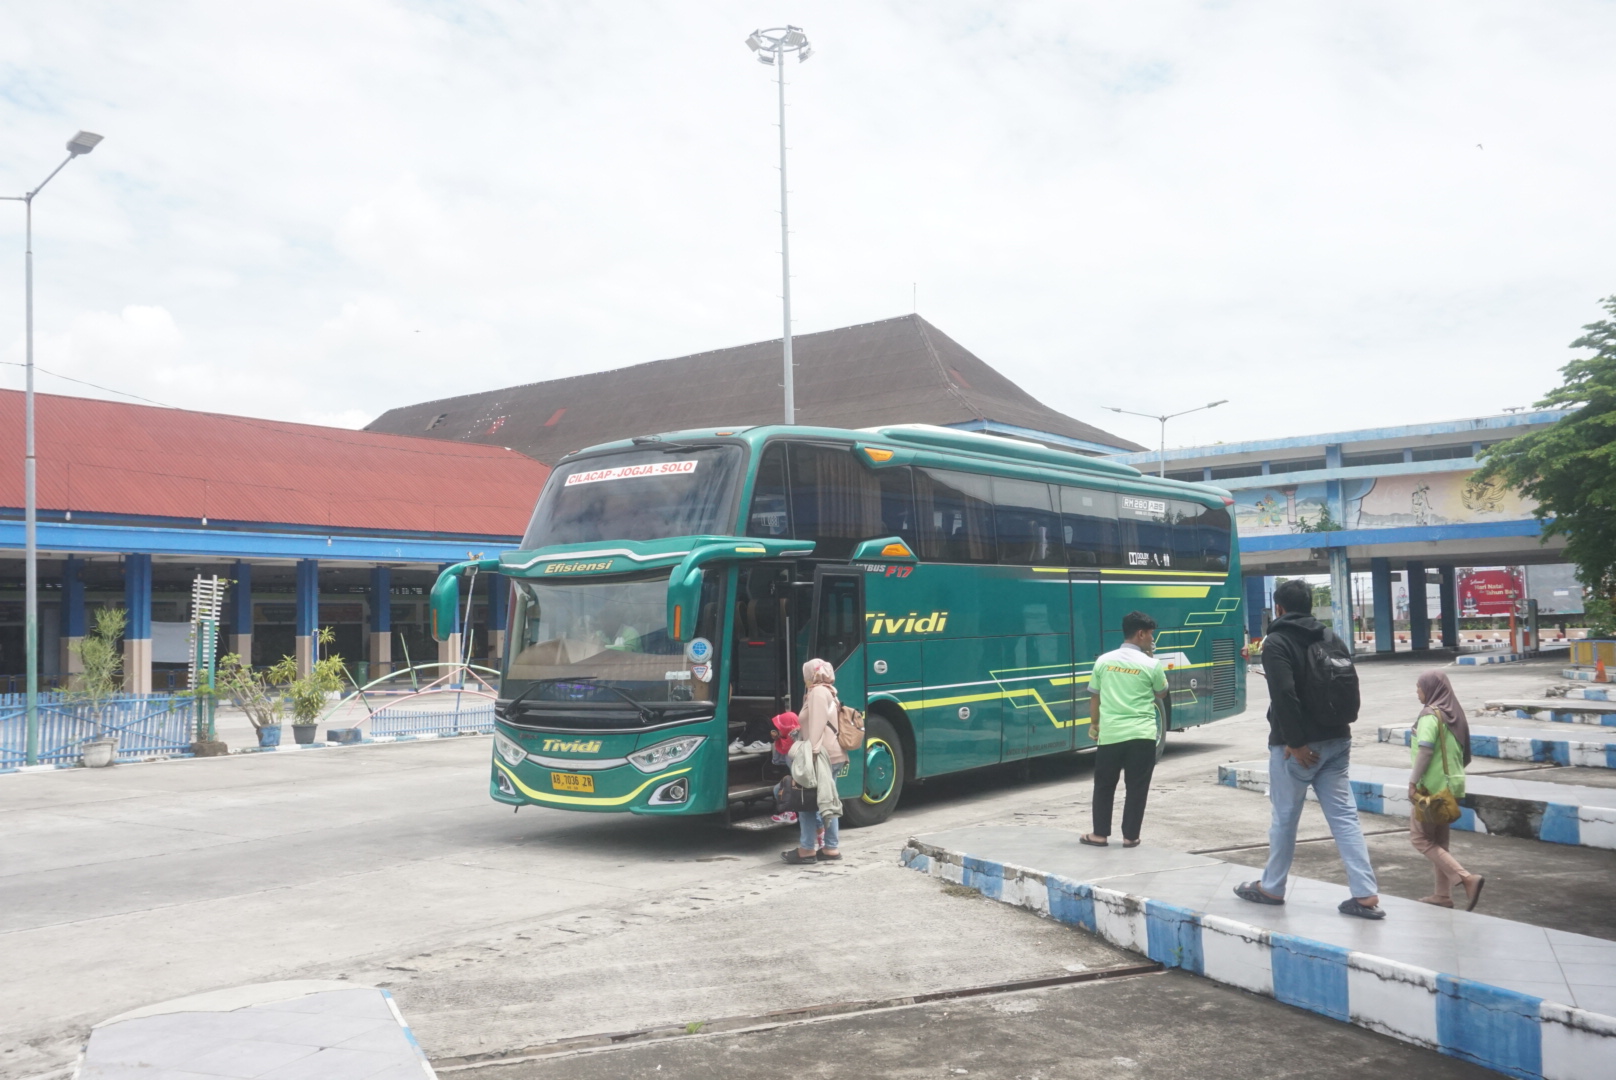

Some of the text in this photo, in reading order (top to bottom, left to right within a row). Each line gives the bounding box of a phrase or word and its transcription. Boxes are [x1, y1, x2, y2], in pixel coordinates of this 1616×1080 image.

[568, 470, 612, 483] CILACAP
[617, 465, 653, 477] JOGJA
[660, 462, 693, 474] SOLO
[544, 560, 613, 573] Efisiensi
[885, 565, 913, 578] F17
[542, 739, 602, 753] Tividi
[553, 774, 561, 784] AB
